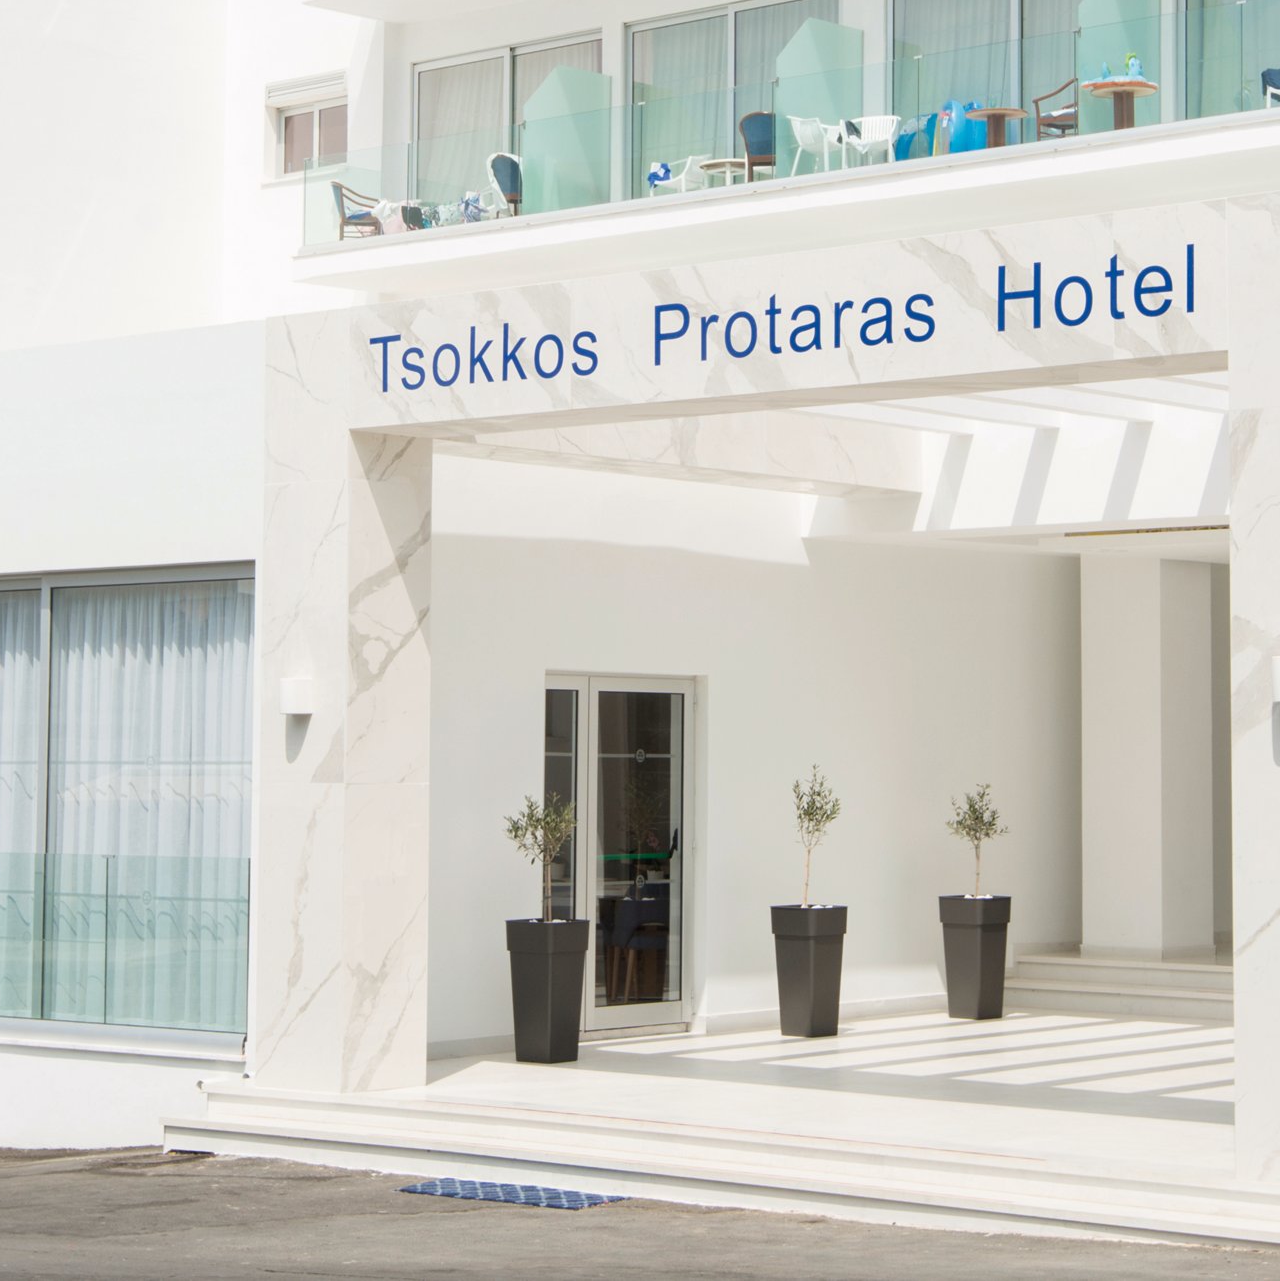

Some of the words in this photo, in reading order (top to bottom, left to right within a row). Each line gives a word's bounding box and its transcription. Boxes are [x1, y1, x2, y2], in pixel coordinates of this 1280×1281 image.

[368, 323, 600, 393] Tsokkos
[653, 293, 937, 368] Protaras
[995, 243, 1196, 333] Hotel
